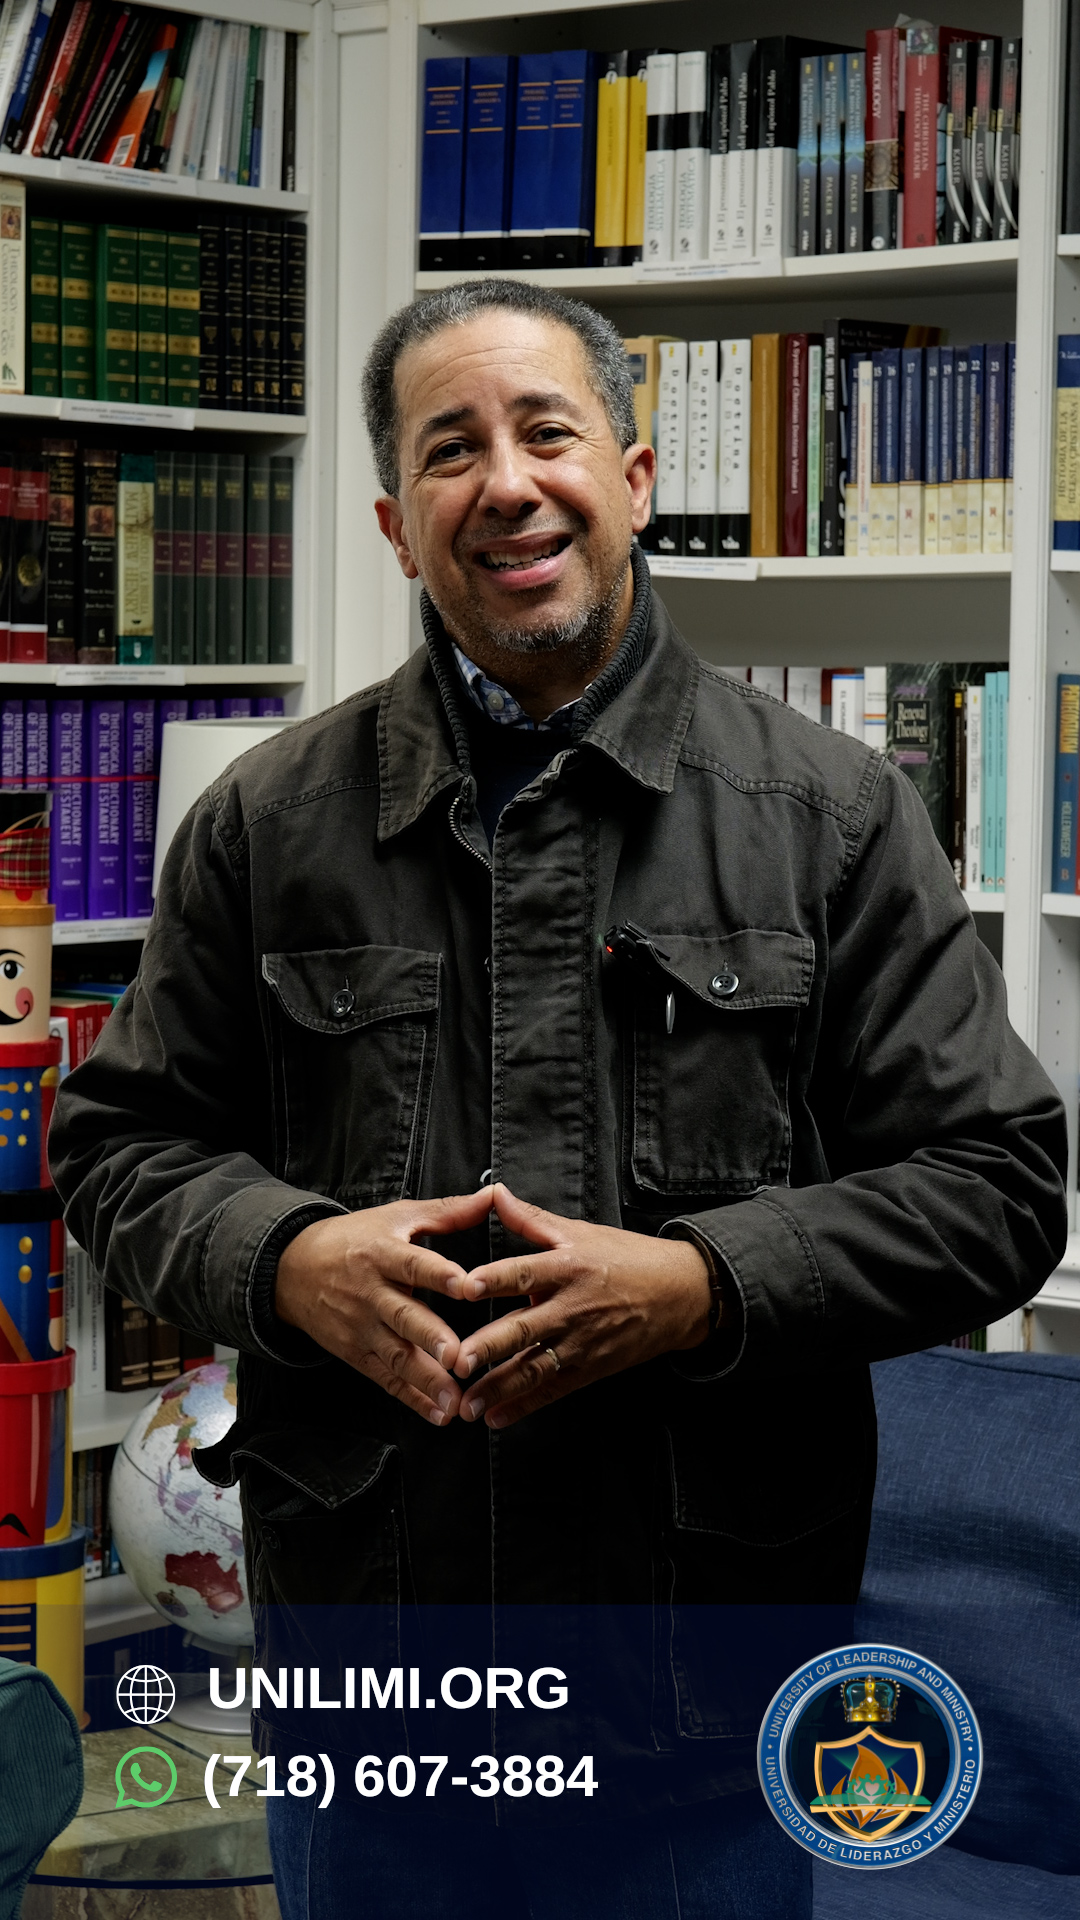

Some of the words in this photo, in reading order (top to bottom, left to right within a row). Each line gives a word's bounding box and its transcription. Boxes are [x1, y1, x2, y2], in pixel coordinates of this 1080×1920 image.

[719, 77, 728, 103] Pablo
[739, 72, 748, 99] Pablo
[767, 69, 777, 96] Pablo
[872, 53, 882, 118] THEOLOGY
[737, 101, 749, 134] apóstol
[766, 98, 777, 131] apóstol
[913, 87, 922, 140] THEOLOGY
[922, 93, 930, 113] THE
[738, 135, 747, 149] del
[766, 133, 775, 147] del
[921, 114, 930, 171] CHRISTIAN
[913, 142, 921, 179] READER
[952, 148, 961, 184] KAISER
[975, 142, 984, 179] KAISER
[1000, 144, 1009, 181] KAISER
[802, 178, 810, 217] PACKER
[825, 176, 833, 216] PACKER
[850, 174, 858, 213] PACKER
[10, 246, 20, 314] THEOLOGY
[791, 348, 800, 377] System
[873, 366, 882, 377] 15
[887, 366, 896, 377] 16
[906, 363, 915, 373] 17
[929, 366, 937, 377] 18
[943, 365, 952, 375] 19
[958, 361, 967, 372] 20
[971, 360, 980, 371] 22
[990, 361, 1000, 372] 23
[791, 378, 800, 386] of
[791, 388, 799, 424] Christian
[824, 391, 835, 411] SPIRIT
[669, 369, 679, 470] Doctrina
[699, 368, 709, 470] Doctrina
[733, 367, 743, 469] Doctrina
[1059, 411, 1068, 425] LA
[1069, 401, 1079, 460] CRISTIANA
[790, 425, 799, 457] Doctrine
[1059, 430, 1067, 443] DE
[790, 459, 799, 489] Volume
[1058, 447, 1068, 498] HISTORIA
[1068, 462, 1077, 504] IGLESIA
[125, 566, 138, 615] HENRY
[2, 712, 12, 725] OF
[27, 712, 37, 725] OF
[61, 712, 71, 725] OF
[99, 712, 109, 725] OF
[132, 712, 143, 724] OF
[897, 702, 927, 721] Renewal
[1059, 684, 1080, 754] PENTECOSTALISM
[2, 730, 12, 747] THE
[13, 713, 23, 775] THEOLOGICAL
[27, 730, 37, 747] THE
[38, 713, 48, 774] THEOLOGICAL
[61, 730, 71, 747] THE
[72, 713, 82, 774] THEOLOGICAL
[99, 730, 109, 747] THE
[109, 713, 120, 774] THEOLOGICAL
[132, 729, 143, 746] THE
[143, 712, 153, 772] THEOLOGICAL
[895, 720, 929, 743] Theology
[2, 753, 12, 776] NEW
[27, 753, 37, 776] NEW
[61, 752, 71, 776] NEW
[99, 752, 109, 776] NEW
[132, 751, 143, 774] NEW
[61, 784, 71, 845] TESTAMENT
[72, 783, 82, 845] DICTIONARY
[99, 783, 109, 844] TESTAMENT
[109, 782, 120, 845] DICTIONARY
[132, 782, 143, 842] TESTAMENT
[143, 781, 153, 843] DICTIONARY
[1060, 801, 1072, 858] HOLLENWEGER
